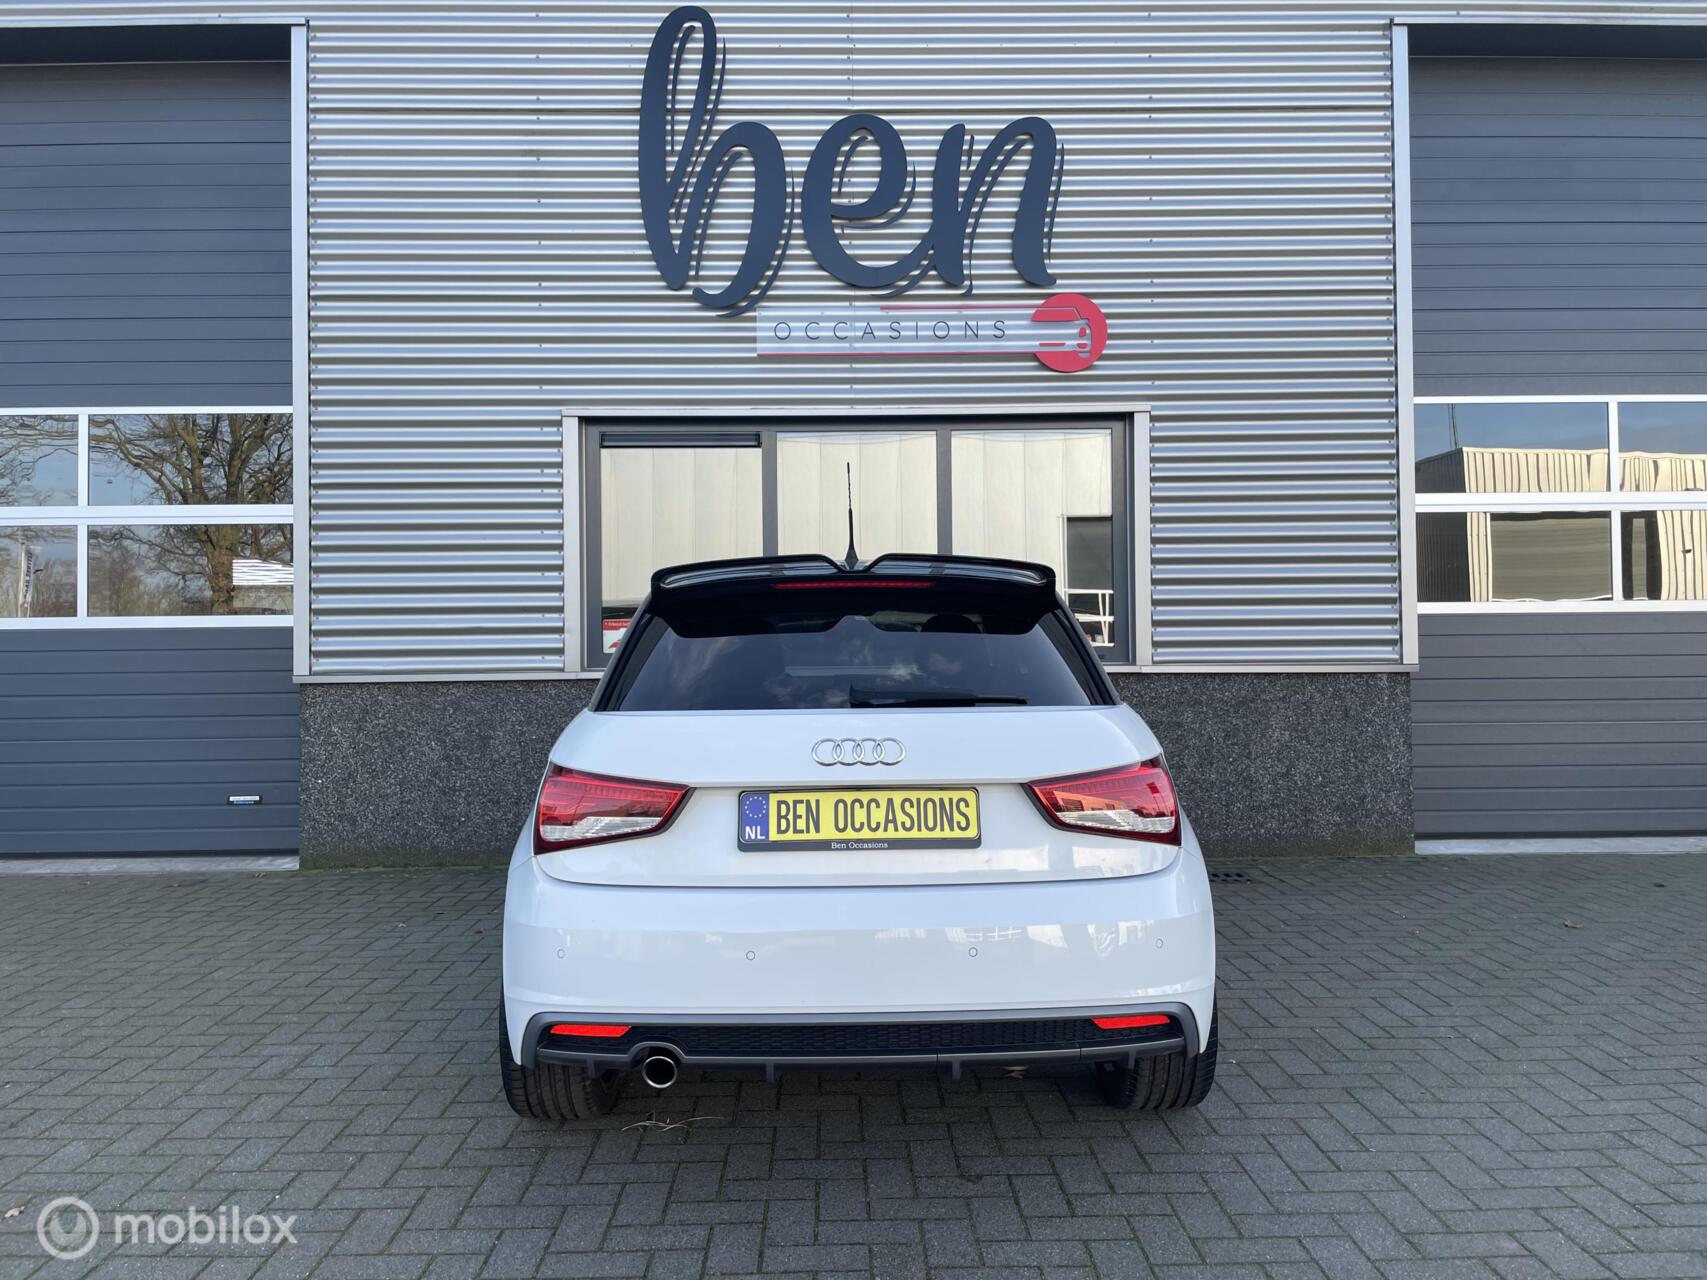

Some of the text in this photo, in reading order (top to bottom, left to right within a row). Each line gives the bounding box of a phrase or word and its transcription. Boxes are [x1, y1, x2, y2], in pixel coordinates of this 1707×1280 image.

[638, 5, 1066, 318] ben
[773, 319, 1007, 342] OCCASIONS
[776, 797, 971, 835] BEN OCCASIONS
[745, 825, 766, 840] NL
[831, 841, 889, 849] Ben Occasions
